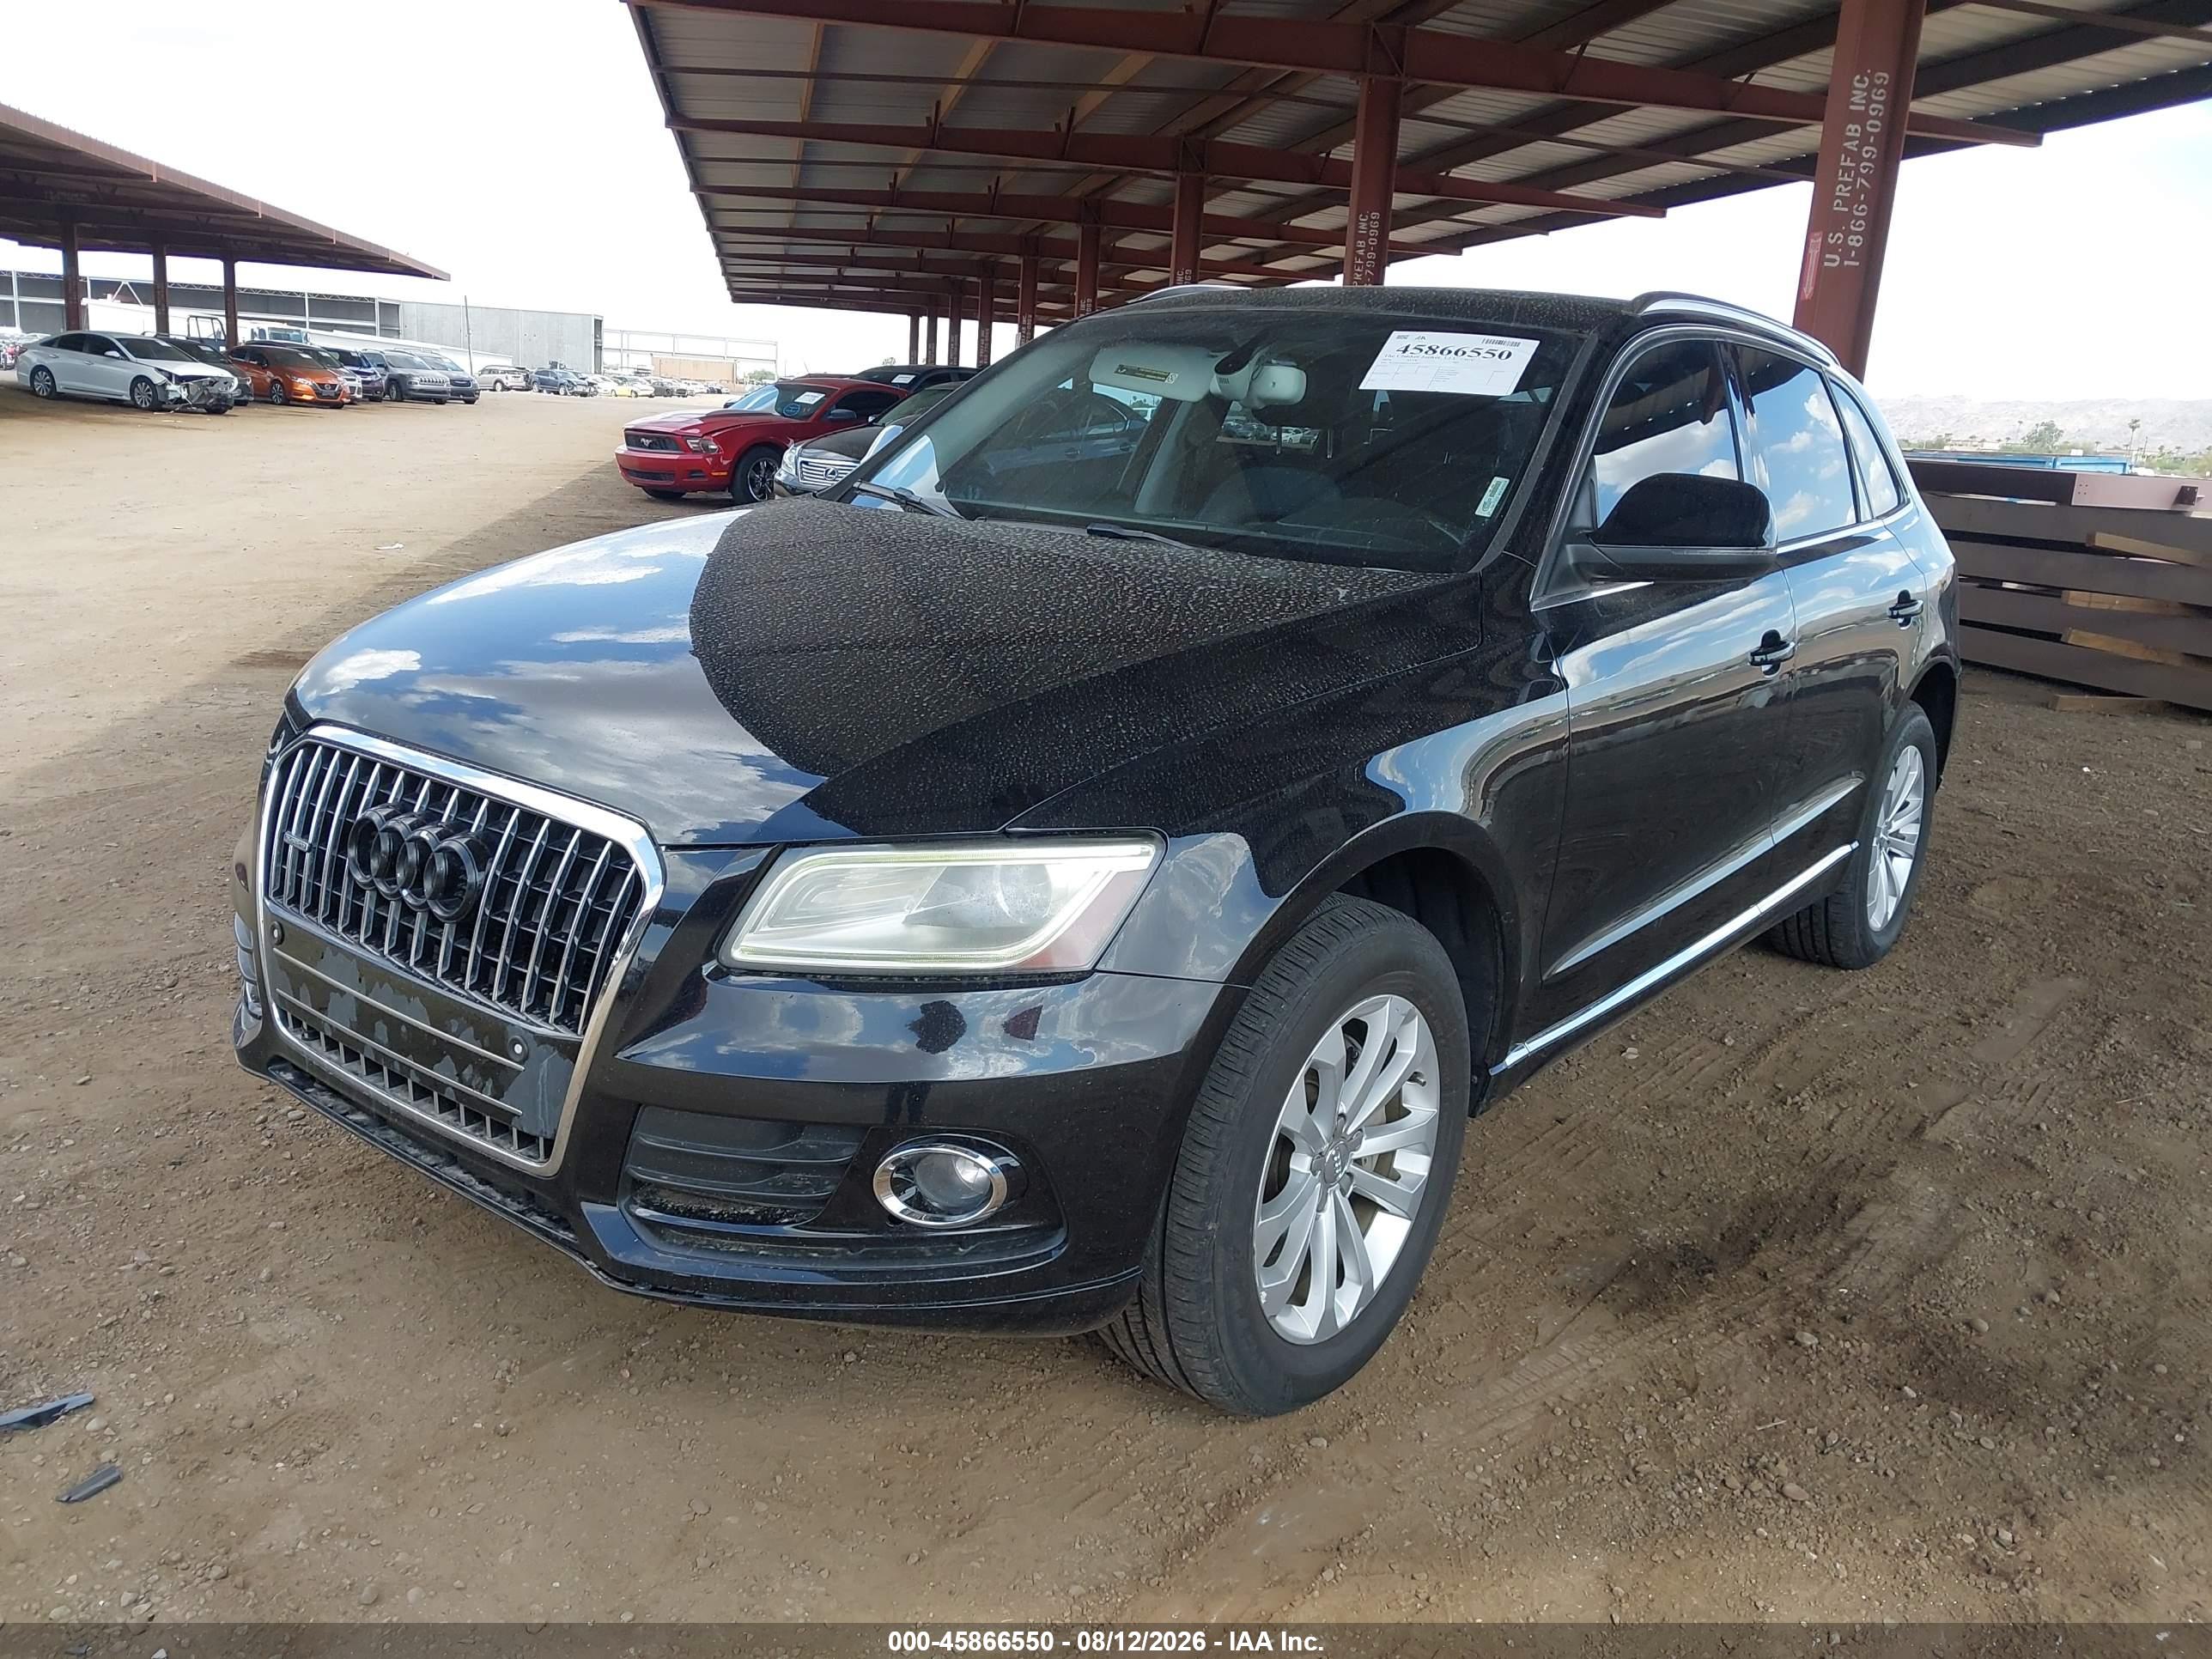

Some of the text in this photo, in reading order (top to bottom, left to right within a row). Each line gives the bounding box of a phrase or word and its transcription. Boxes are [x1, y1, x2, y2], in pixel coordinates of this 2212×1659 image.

[1823, 68, 1871, 267] U.S. PREFAB INC.
[1844, 71, 1889, 267] 1-866-799-0969
[1395, 343, 1512, 361] 45866550
